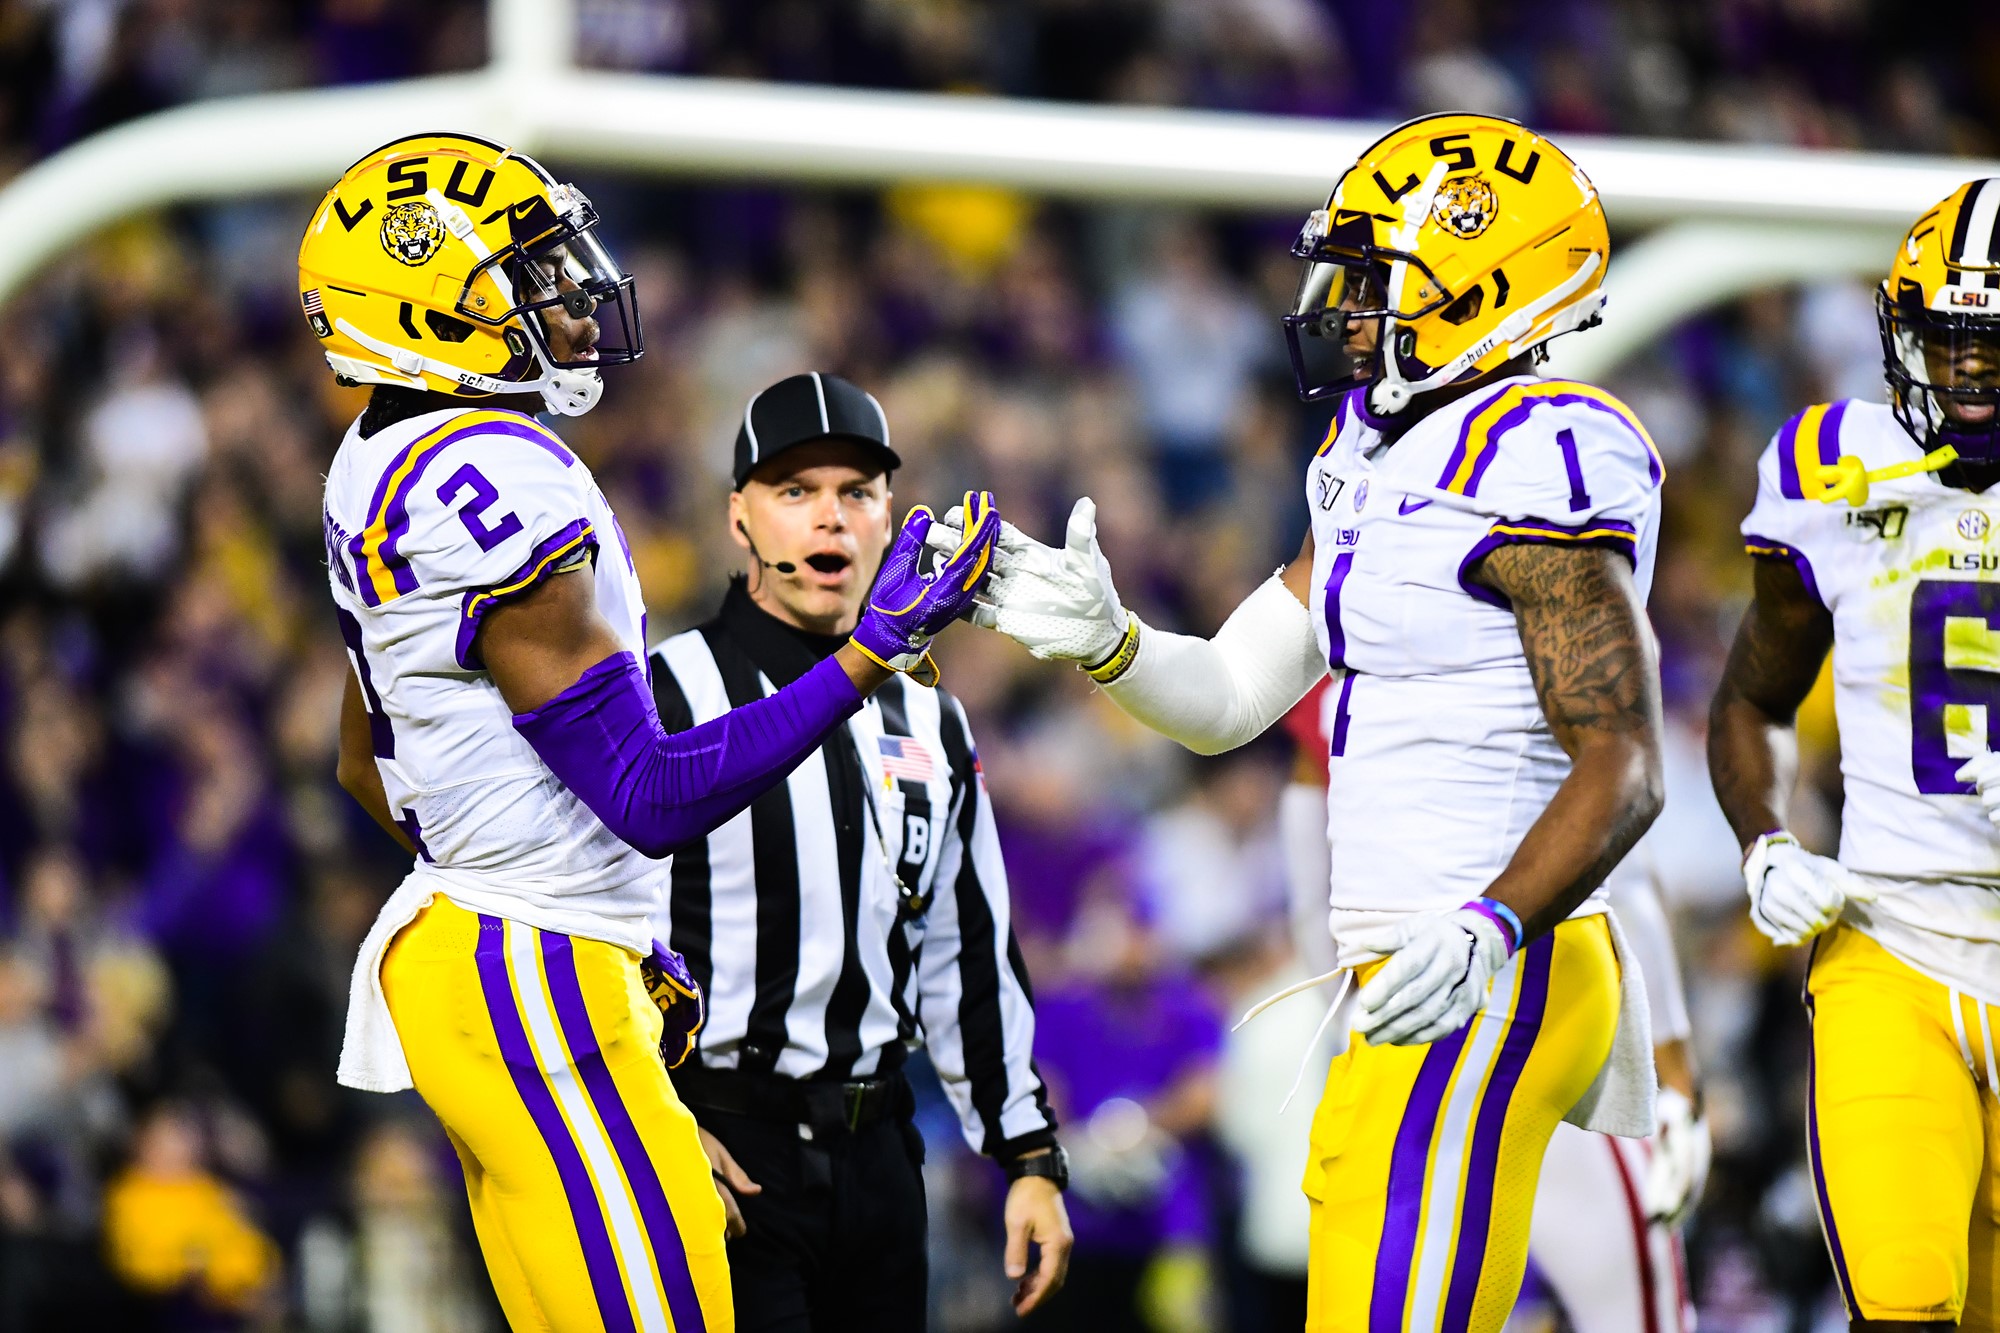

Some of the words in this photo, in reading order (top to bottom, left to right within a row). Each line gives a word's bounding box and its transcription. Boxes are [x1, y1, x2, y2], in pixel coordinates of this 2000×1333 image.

[333, 156, 497, 233] LSU
[1372, 134, 1541, 205] LSU
[1950, 291, 1989, 308] LSU
[1556, 428, 1591, 512] 1
[436, 463, 524, 553] 2
[1336, 528, 1361, 546] LSU
[1948, 554, 1999, 570] LSU
[904, 814, 930, 865] B
